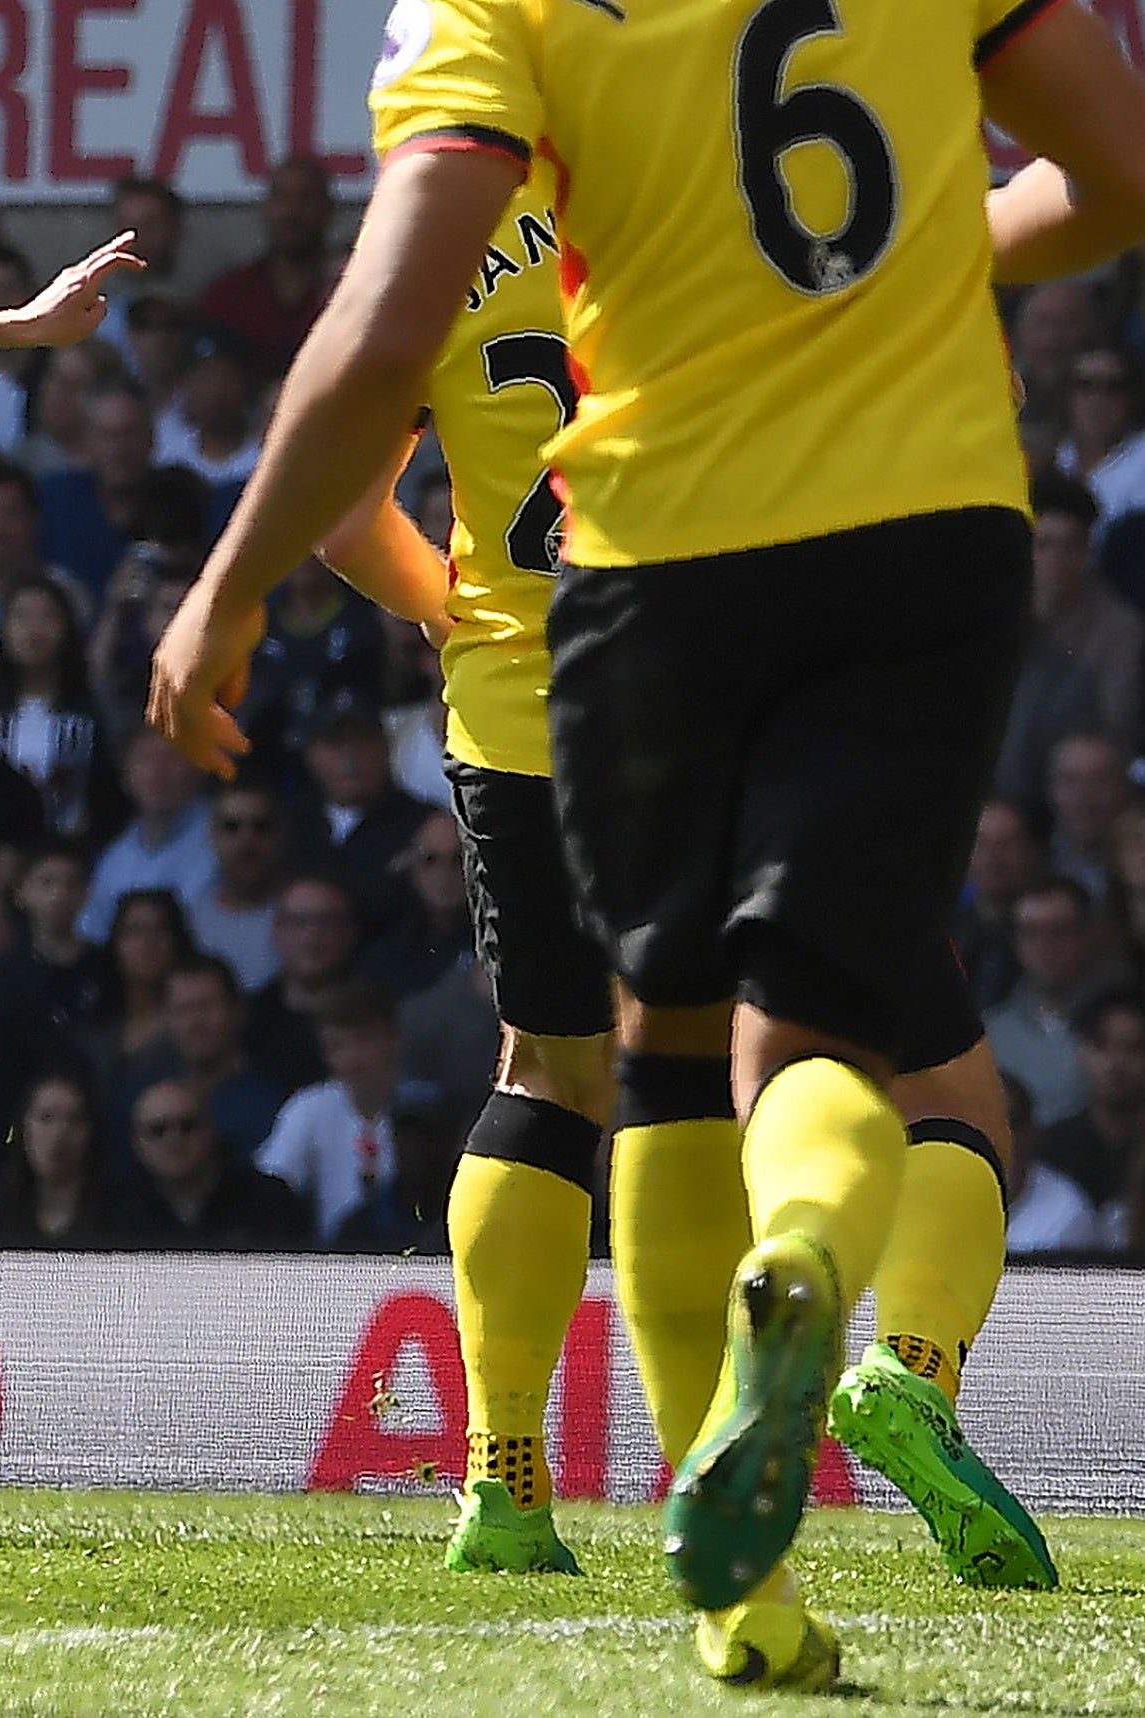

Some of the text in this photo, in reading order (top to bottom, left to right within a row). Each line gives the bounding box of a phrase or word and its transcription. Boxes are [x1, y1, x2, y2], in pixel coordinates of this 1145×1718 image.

[730, 0, 900, 297] 6
[480, 330, 578, 578] 2
[305, 1289, 857, 1508] AI
